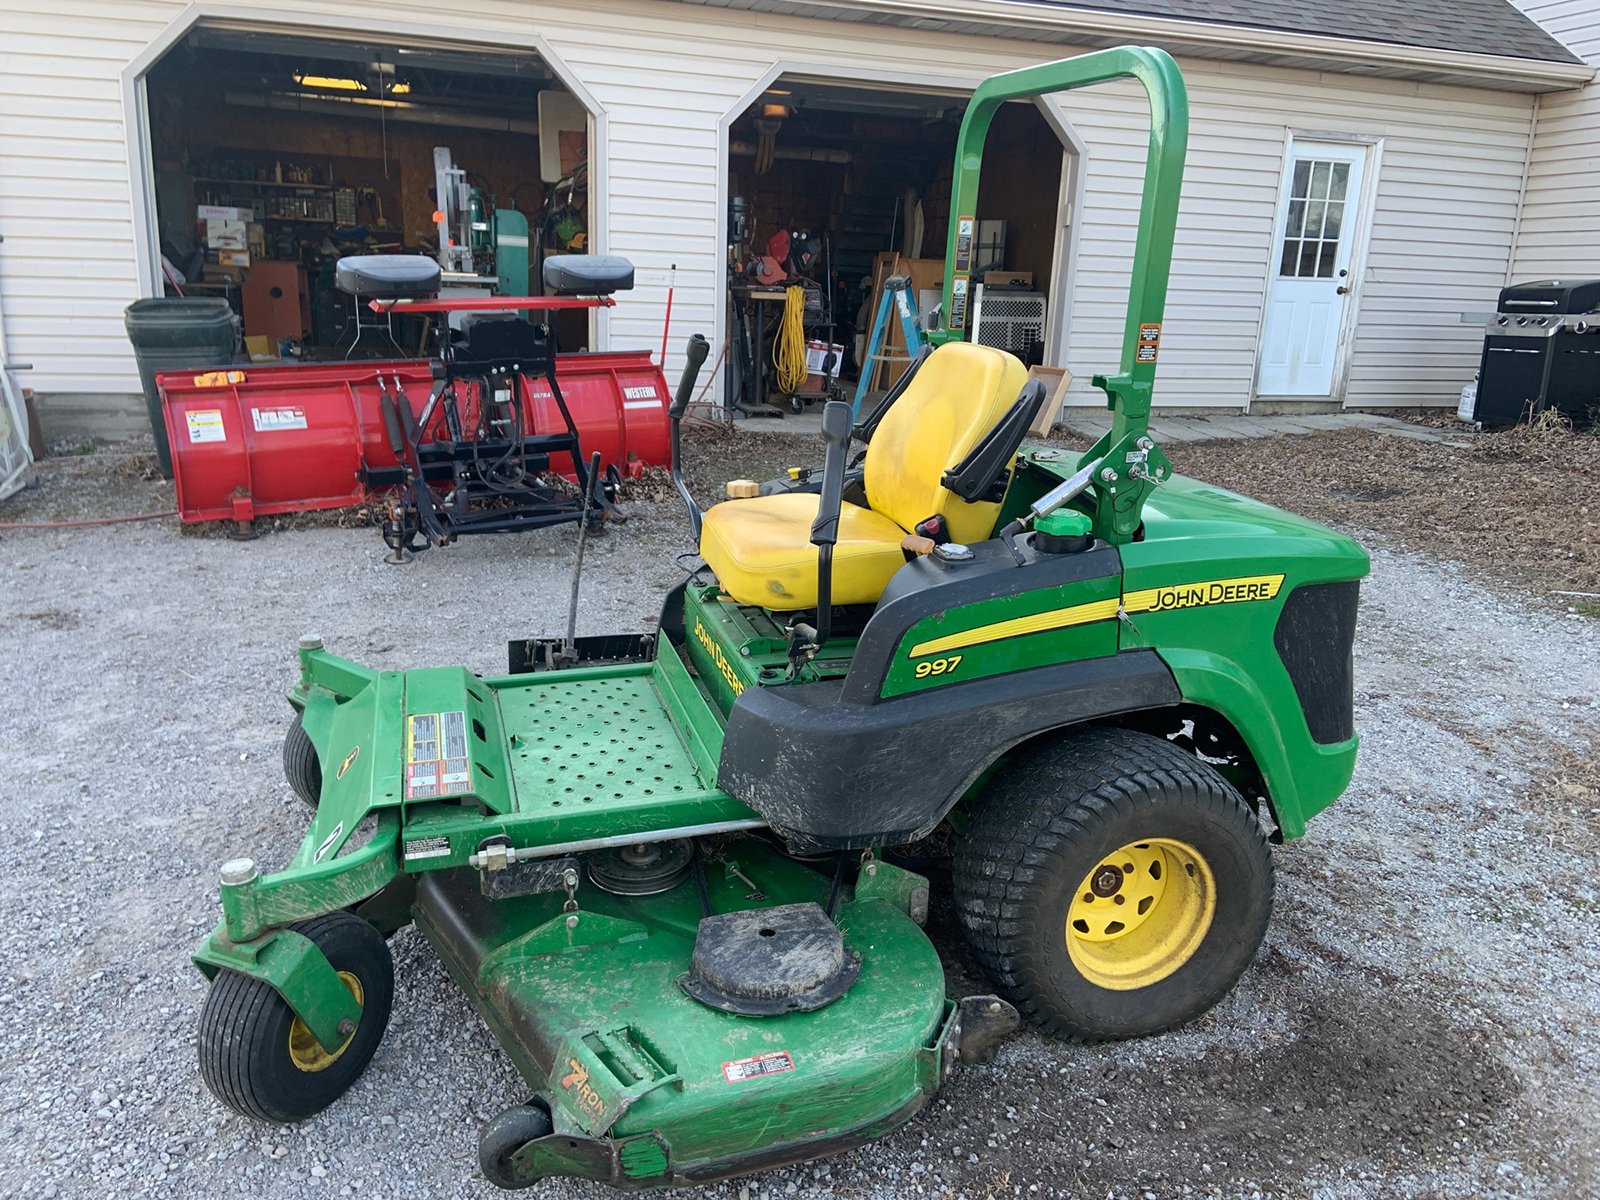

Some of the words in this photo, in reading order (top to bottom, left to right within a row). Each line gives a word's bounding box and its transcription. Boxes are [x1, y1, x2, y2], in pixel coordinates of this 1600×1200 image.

[623, 386, 657, 399] WESTERN
[1149, 588, 1204, 609] JOHN
[1209, 583, 1271, 602] DEERE
[694, 615, 716, 661] JOHN
[914, 655, 963, 679] 997
